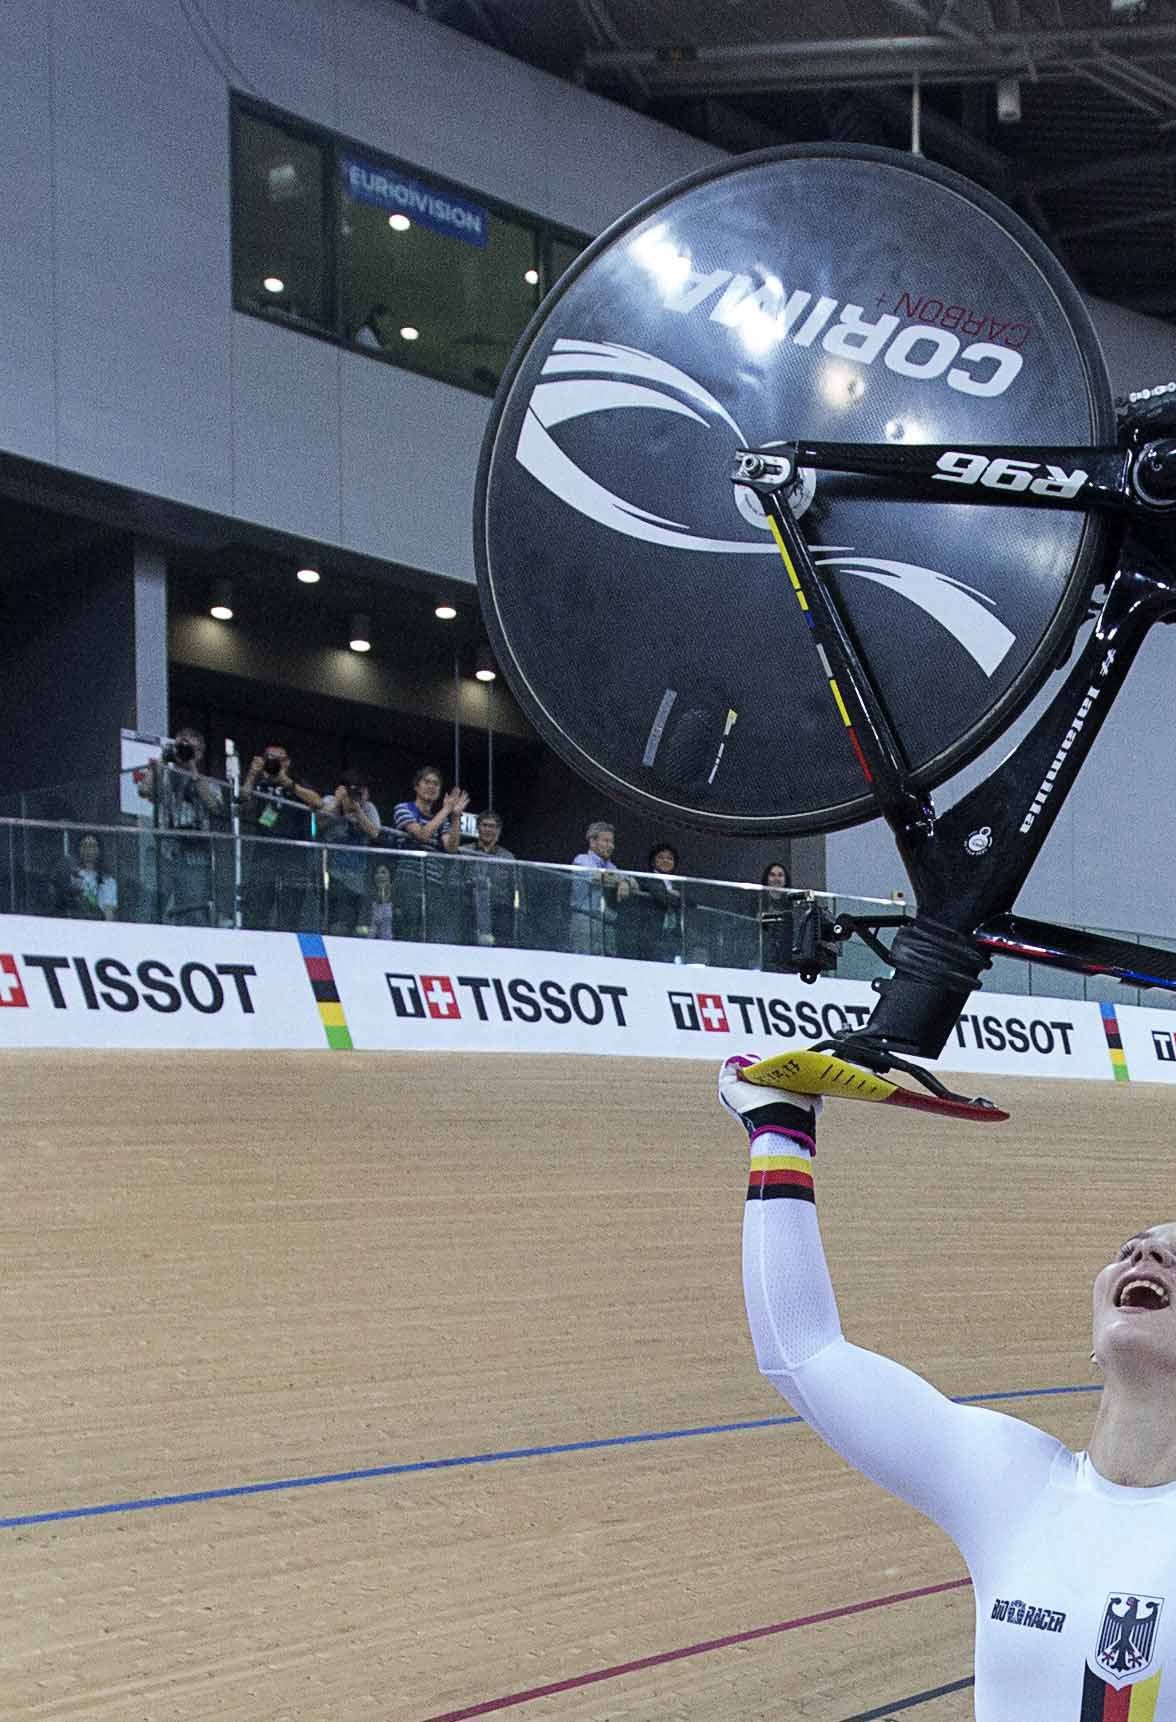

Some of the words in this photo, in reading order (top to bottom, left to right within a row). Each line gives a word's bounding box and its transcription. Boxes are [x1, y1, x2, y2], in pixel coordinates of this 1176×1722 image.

[349, 165, 482, 233] EUROVISION
[662, 261, 1023, 398] CORIMA
[898, 291, 1032, 351] CARBON
[937, 450, 1089, 499] R96
[21, 953, 258, 1015] TISSOT
[457, 976, 628, 1028] TISSOT
[727, 995, 871, 1041] TISSOT
[954, 1014, 1074, 1056] TISSOT
[1022, 1605, 1067, 1633] RACER
